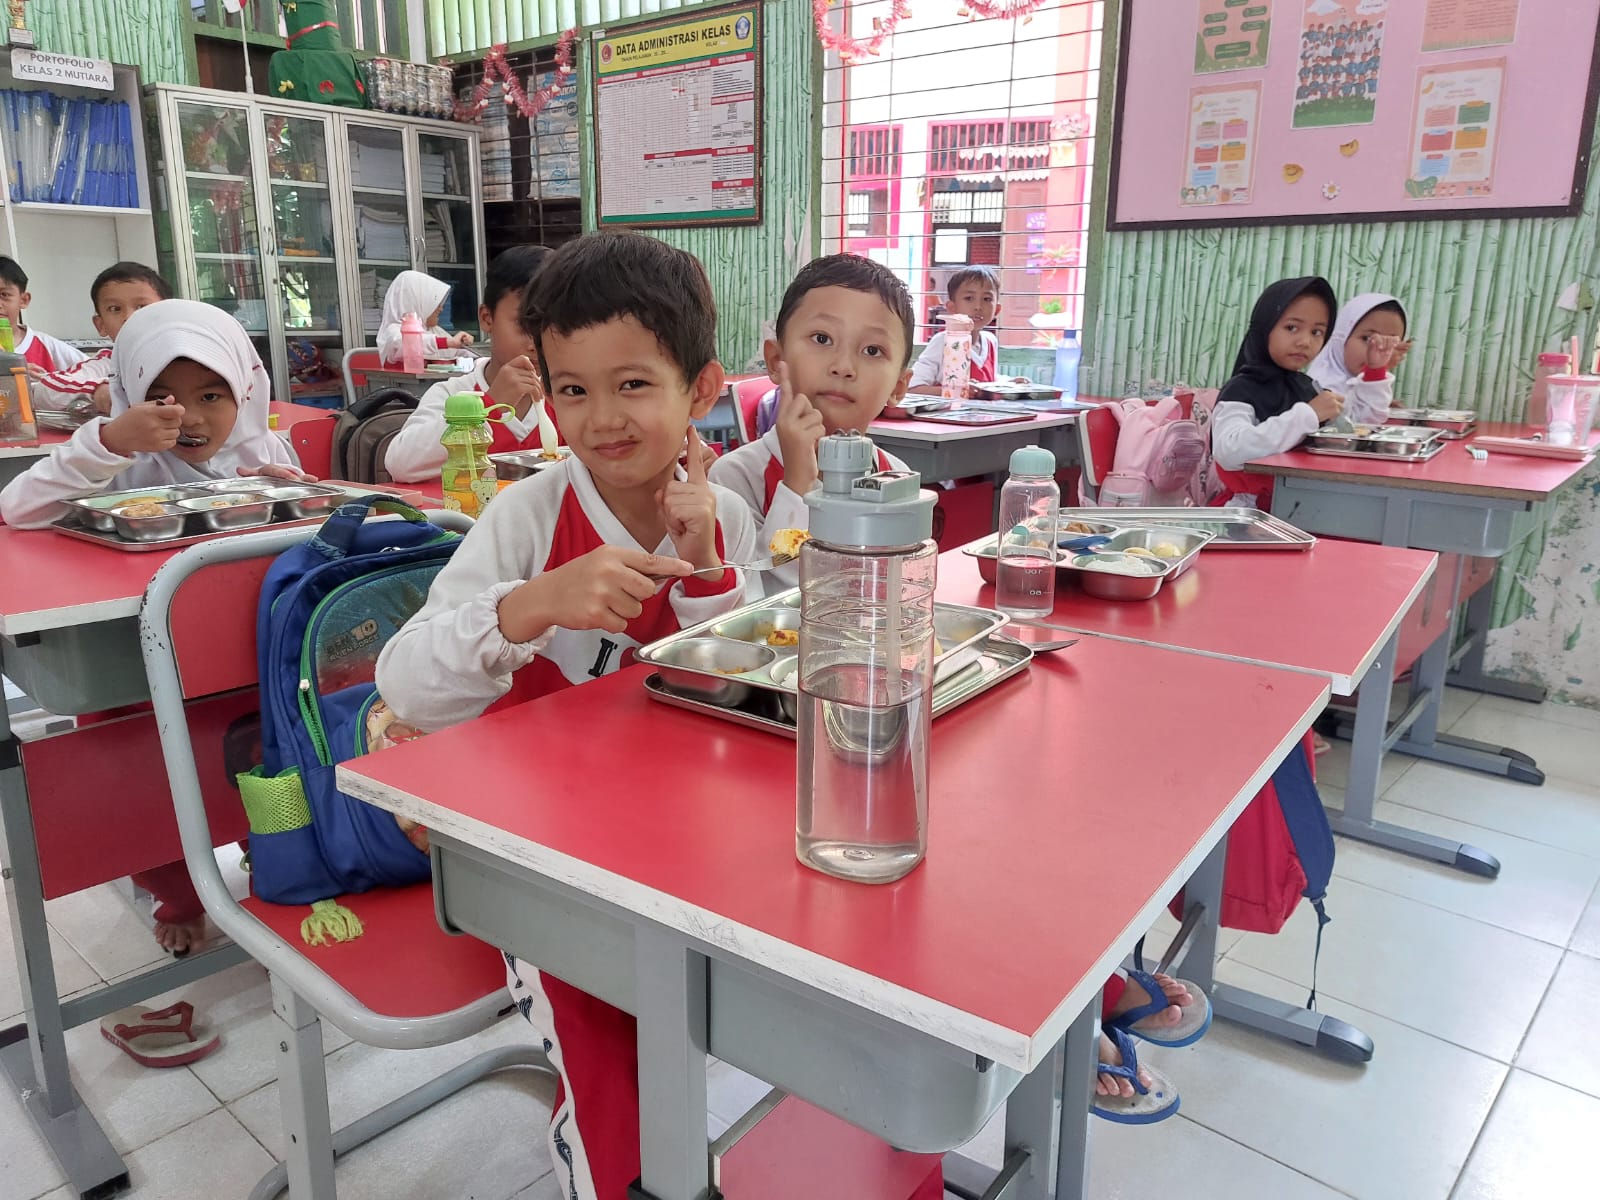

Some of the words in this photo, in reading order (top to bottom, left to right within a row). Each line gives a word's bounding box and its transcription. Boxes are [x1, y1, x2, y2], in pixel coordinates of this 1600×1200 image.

[616, 43, 636, 56] DATA
[639, 30, 699, 52] ADMINISTRASI
[702, 24, 731, 40] KELAS
[30, 53, 94, 70] PORTOFOLIO
[20, 63, 53, 76] KELAS
[55, 68, 62, 77] 2
[64, 70, 109, 83] MUTIARA
